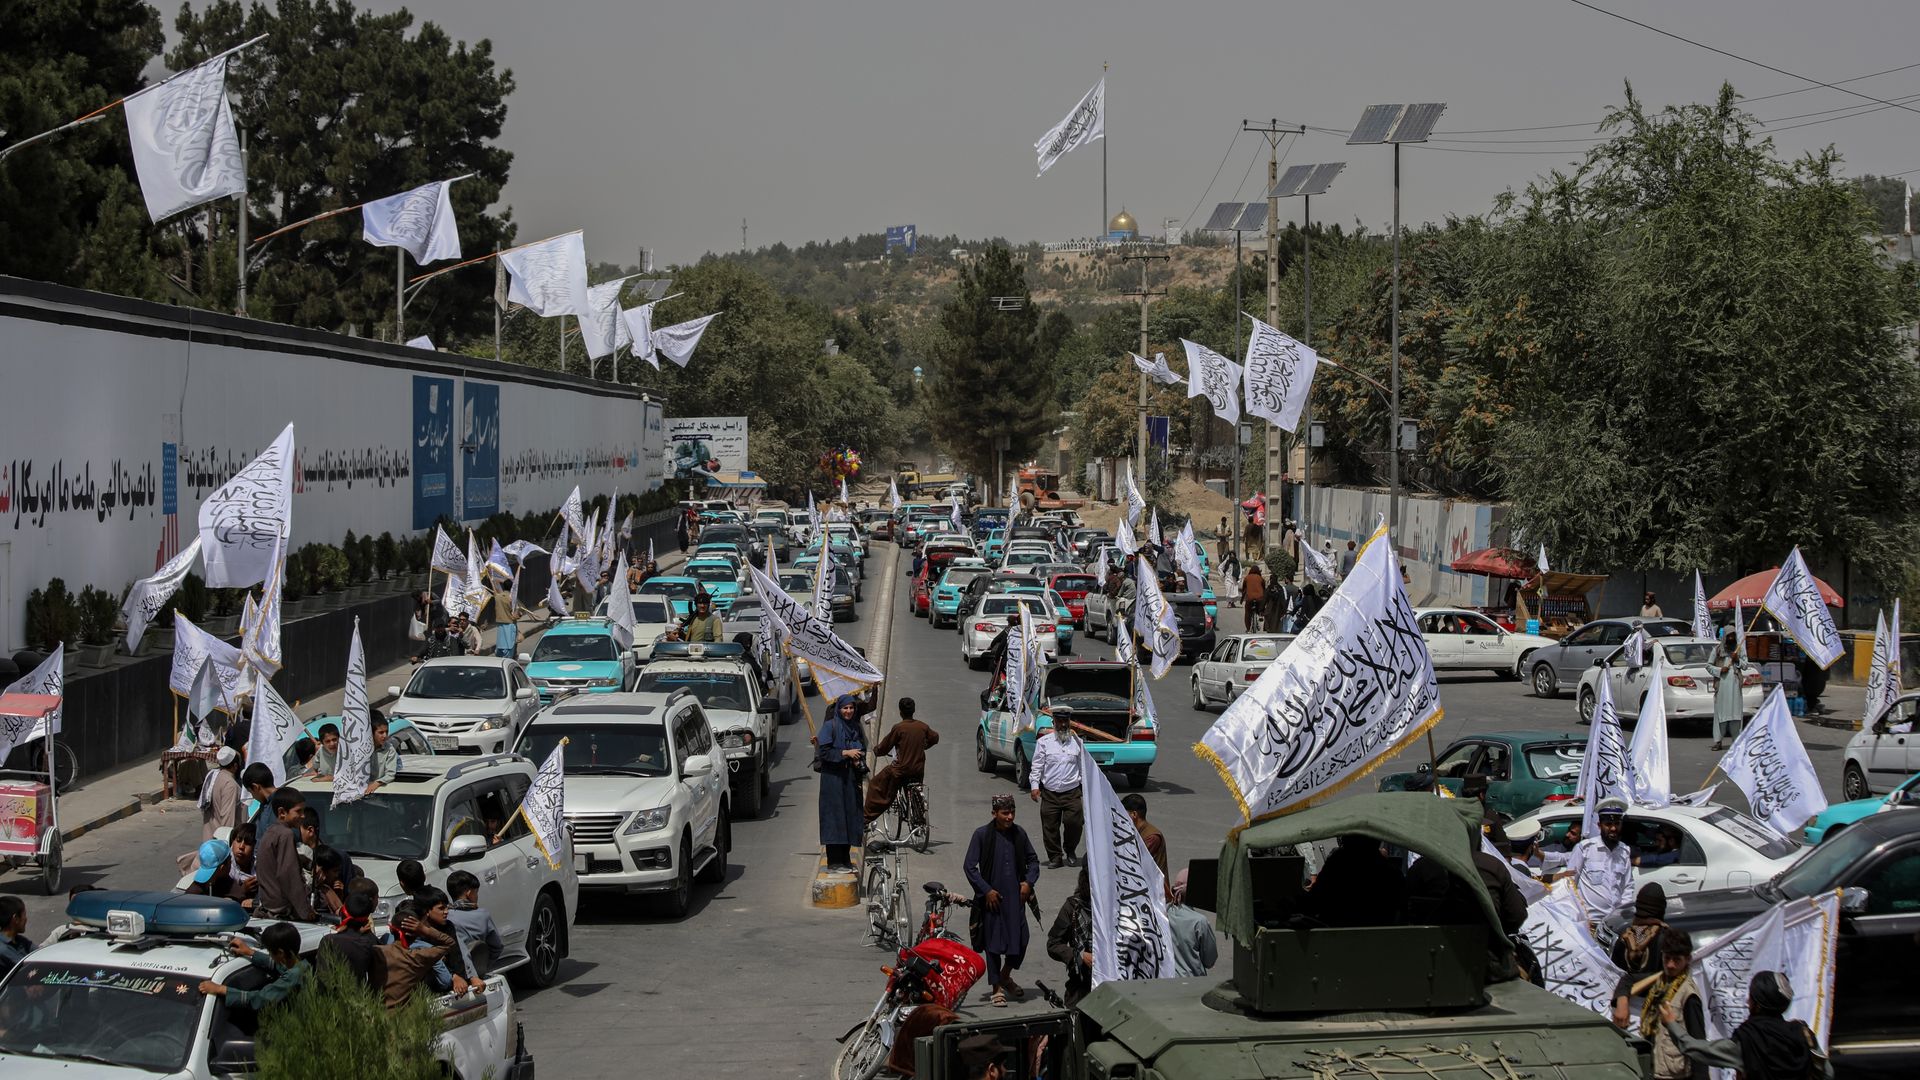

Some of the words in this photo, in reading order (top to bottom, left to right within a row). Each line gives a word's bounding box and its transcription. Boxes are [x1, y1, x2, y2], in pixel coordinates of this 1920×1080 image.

[12, 459, 20, 530] را
[21, 458, 56, 529] امریکا
[58, 458, 69, 512] ما
[71, 460, 95, 511] ملت
[121, 463, 146, 521] نصرت
[147, 460, 156, 518] با
